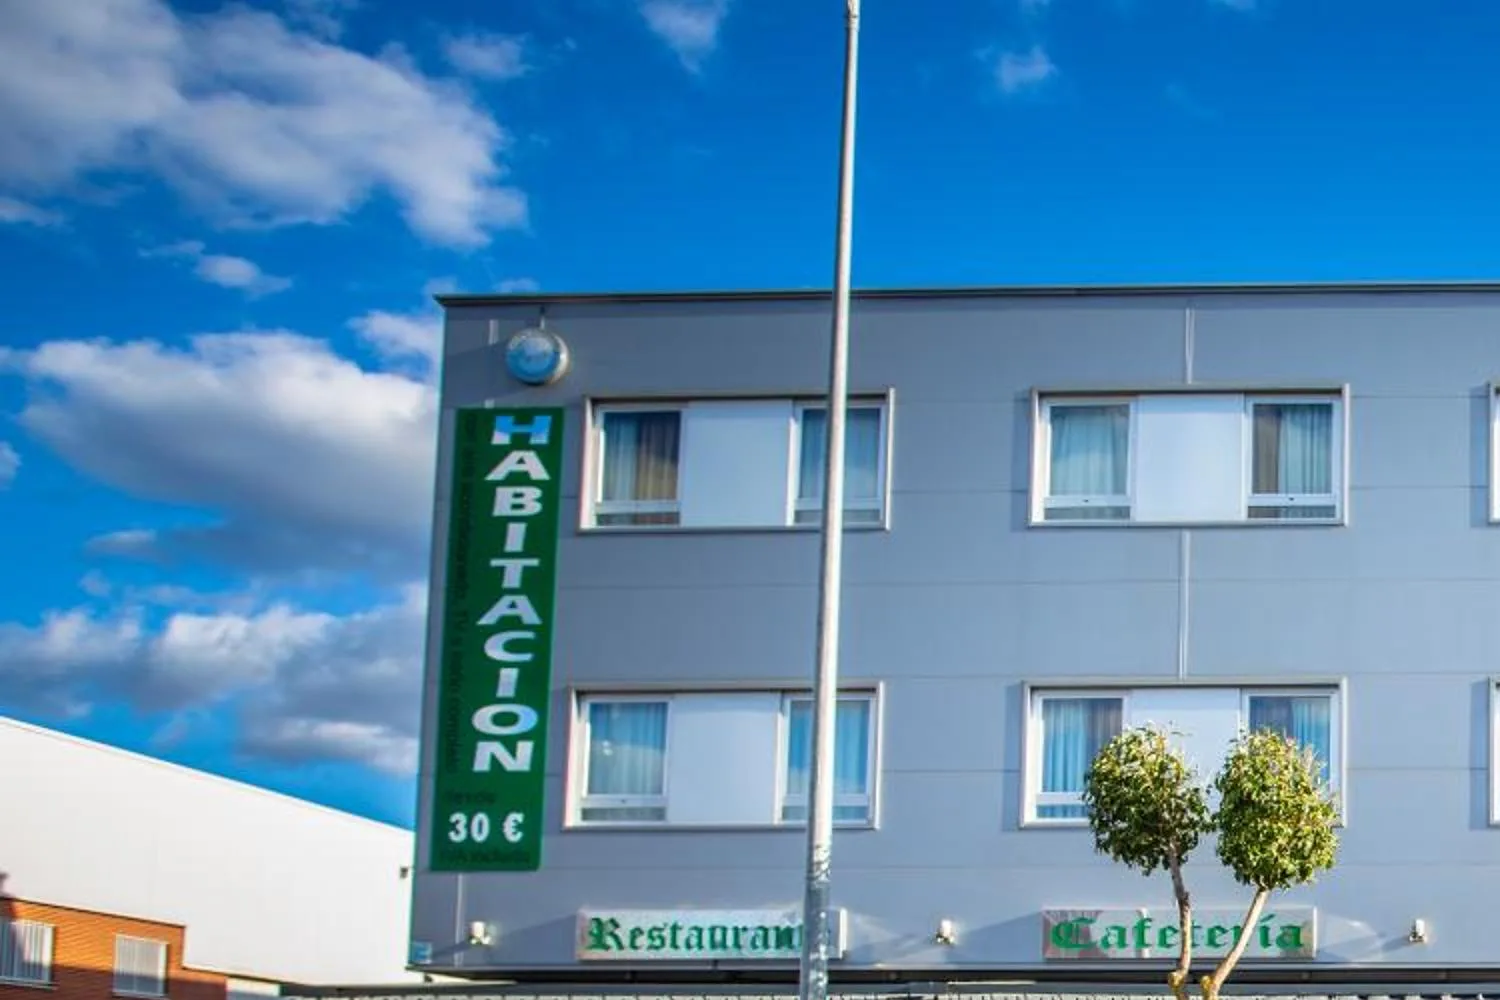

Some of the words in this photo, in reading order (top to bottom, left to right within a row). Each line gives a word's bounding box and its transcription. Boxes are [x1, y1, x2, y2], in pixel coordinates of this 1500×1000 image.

[472, 415, 552, 772] HABITACION
[449, 811, 490, 843] 30
[503, 811, 524, 843] €
[588, 917, 804, 951] Restauran
